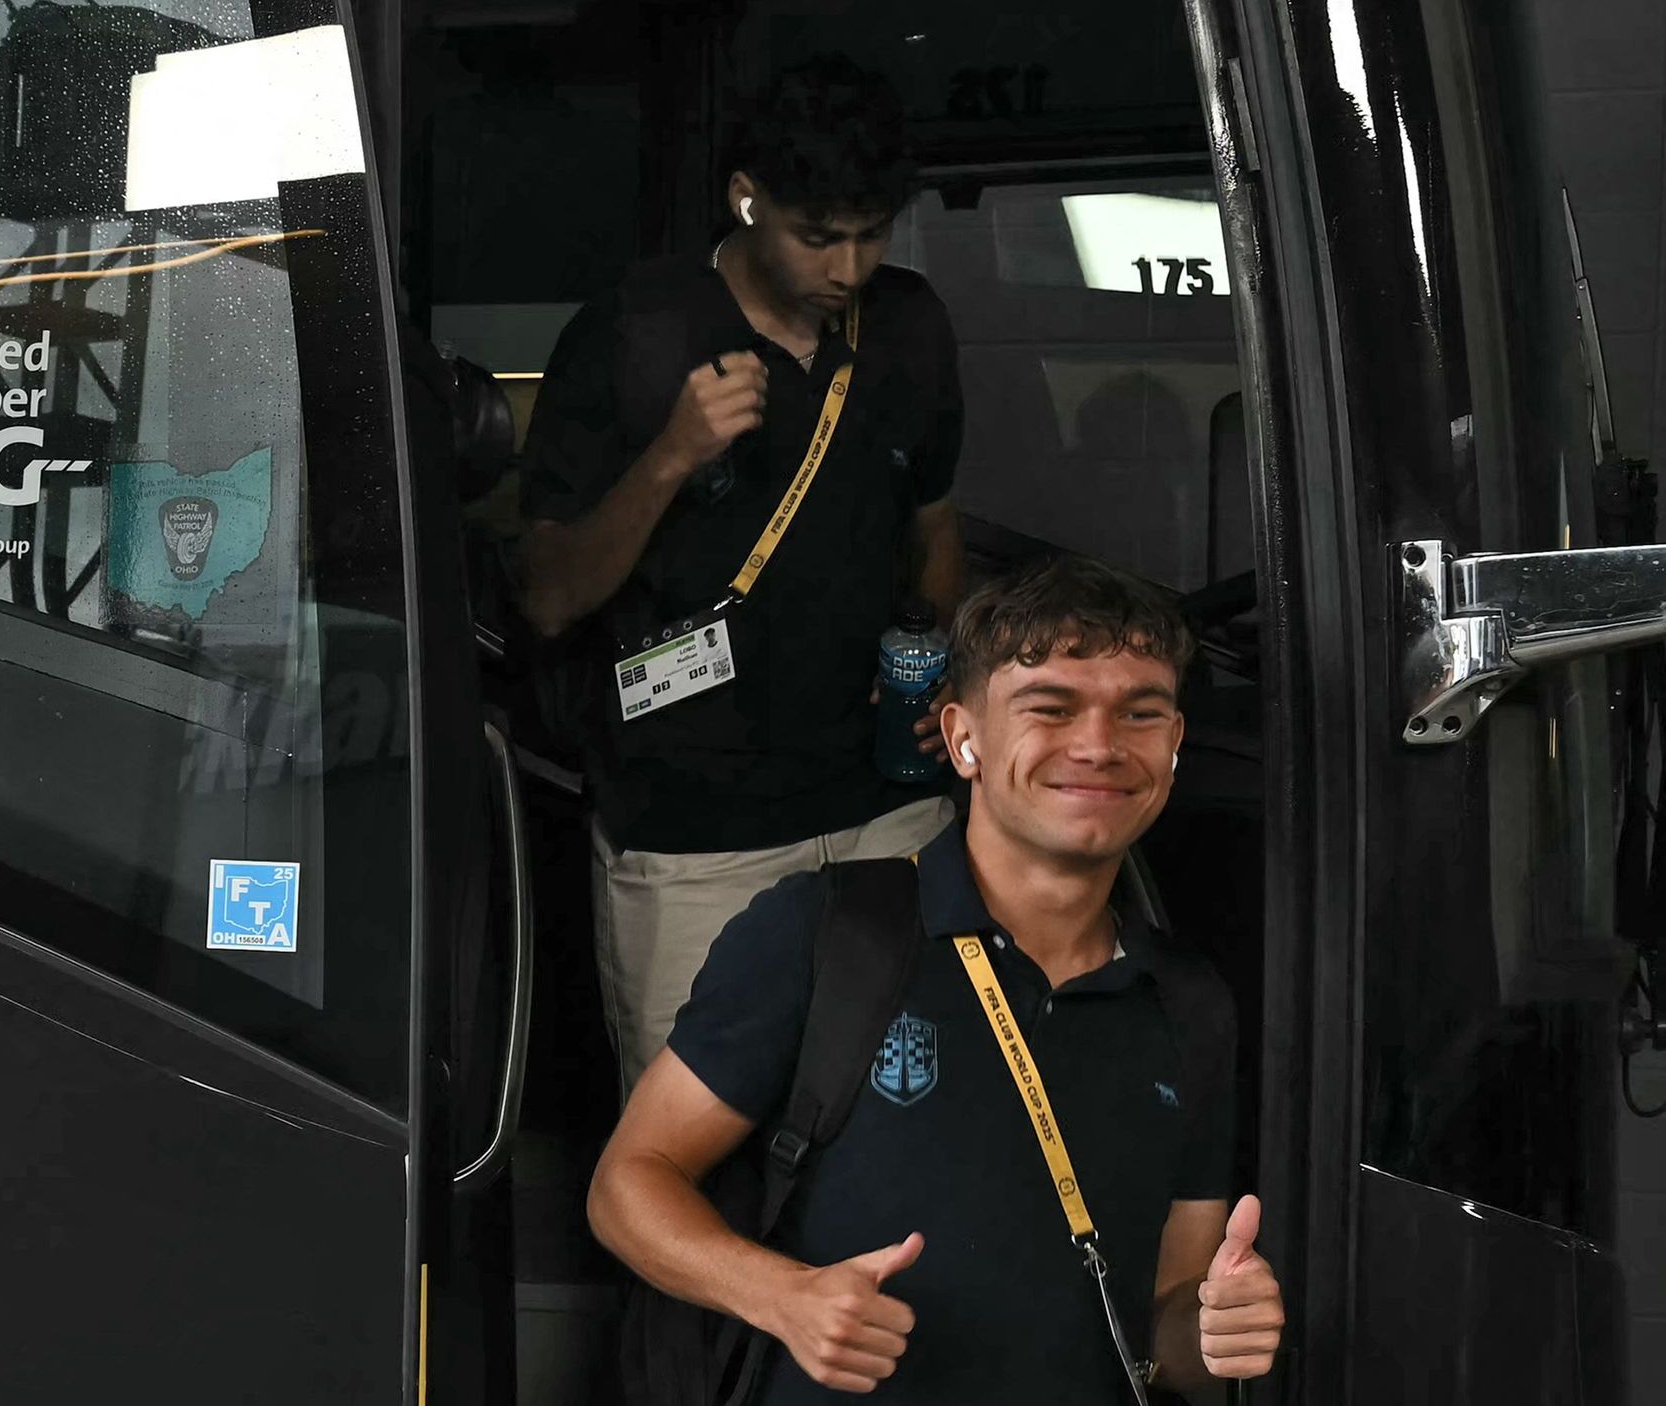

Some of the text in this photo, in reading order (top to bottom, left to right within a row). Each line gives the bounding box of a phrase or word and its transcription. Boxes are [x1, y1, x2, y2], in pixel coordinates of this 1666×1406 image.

[1132, 257, 1213, 297] 175
[795, 460, 814, 492] WORLD
[811, 441, 822, 460] CUP
[176, 503, 199, 513] STATE
[169, 512, 207, 522] HIGHWAY
[173, 522, 202, 531] PATROL
[175, 565, 199, 574] OHIO
[892, 667, 924, 682] ADE
[273, 867, 294, 880] 25
[213, 932, 236, 944] OH
[984, 986, 1000, 1012] FIFA
[996, 1012, 1014, 1041] CLUB
[1009, 1042, 1032, 1084] WORLD
[1027, 1086, 1042, 1109] CUP
